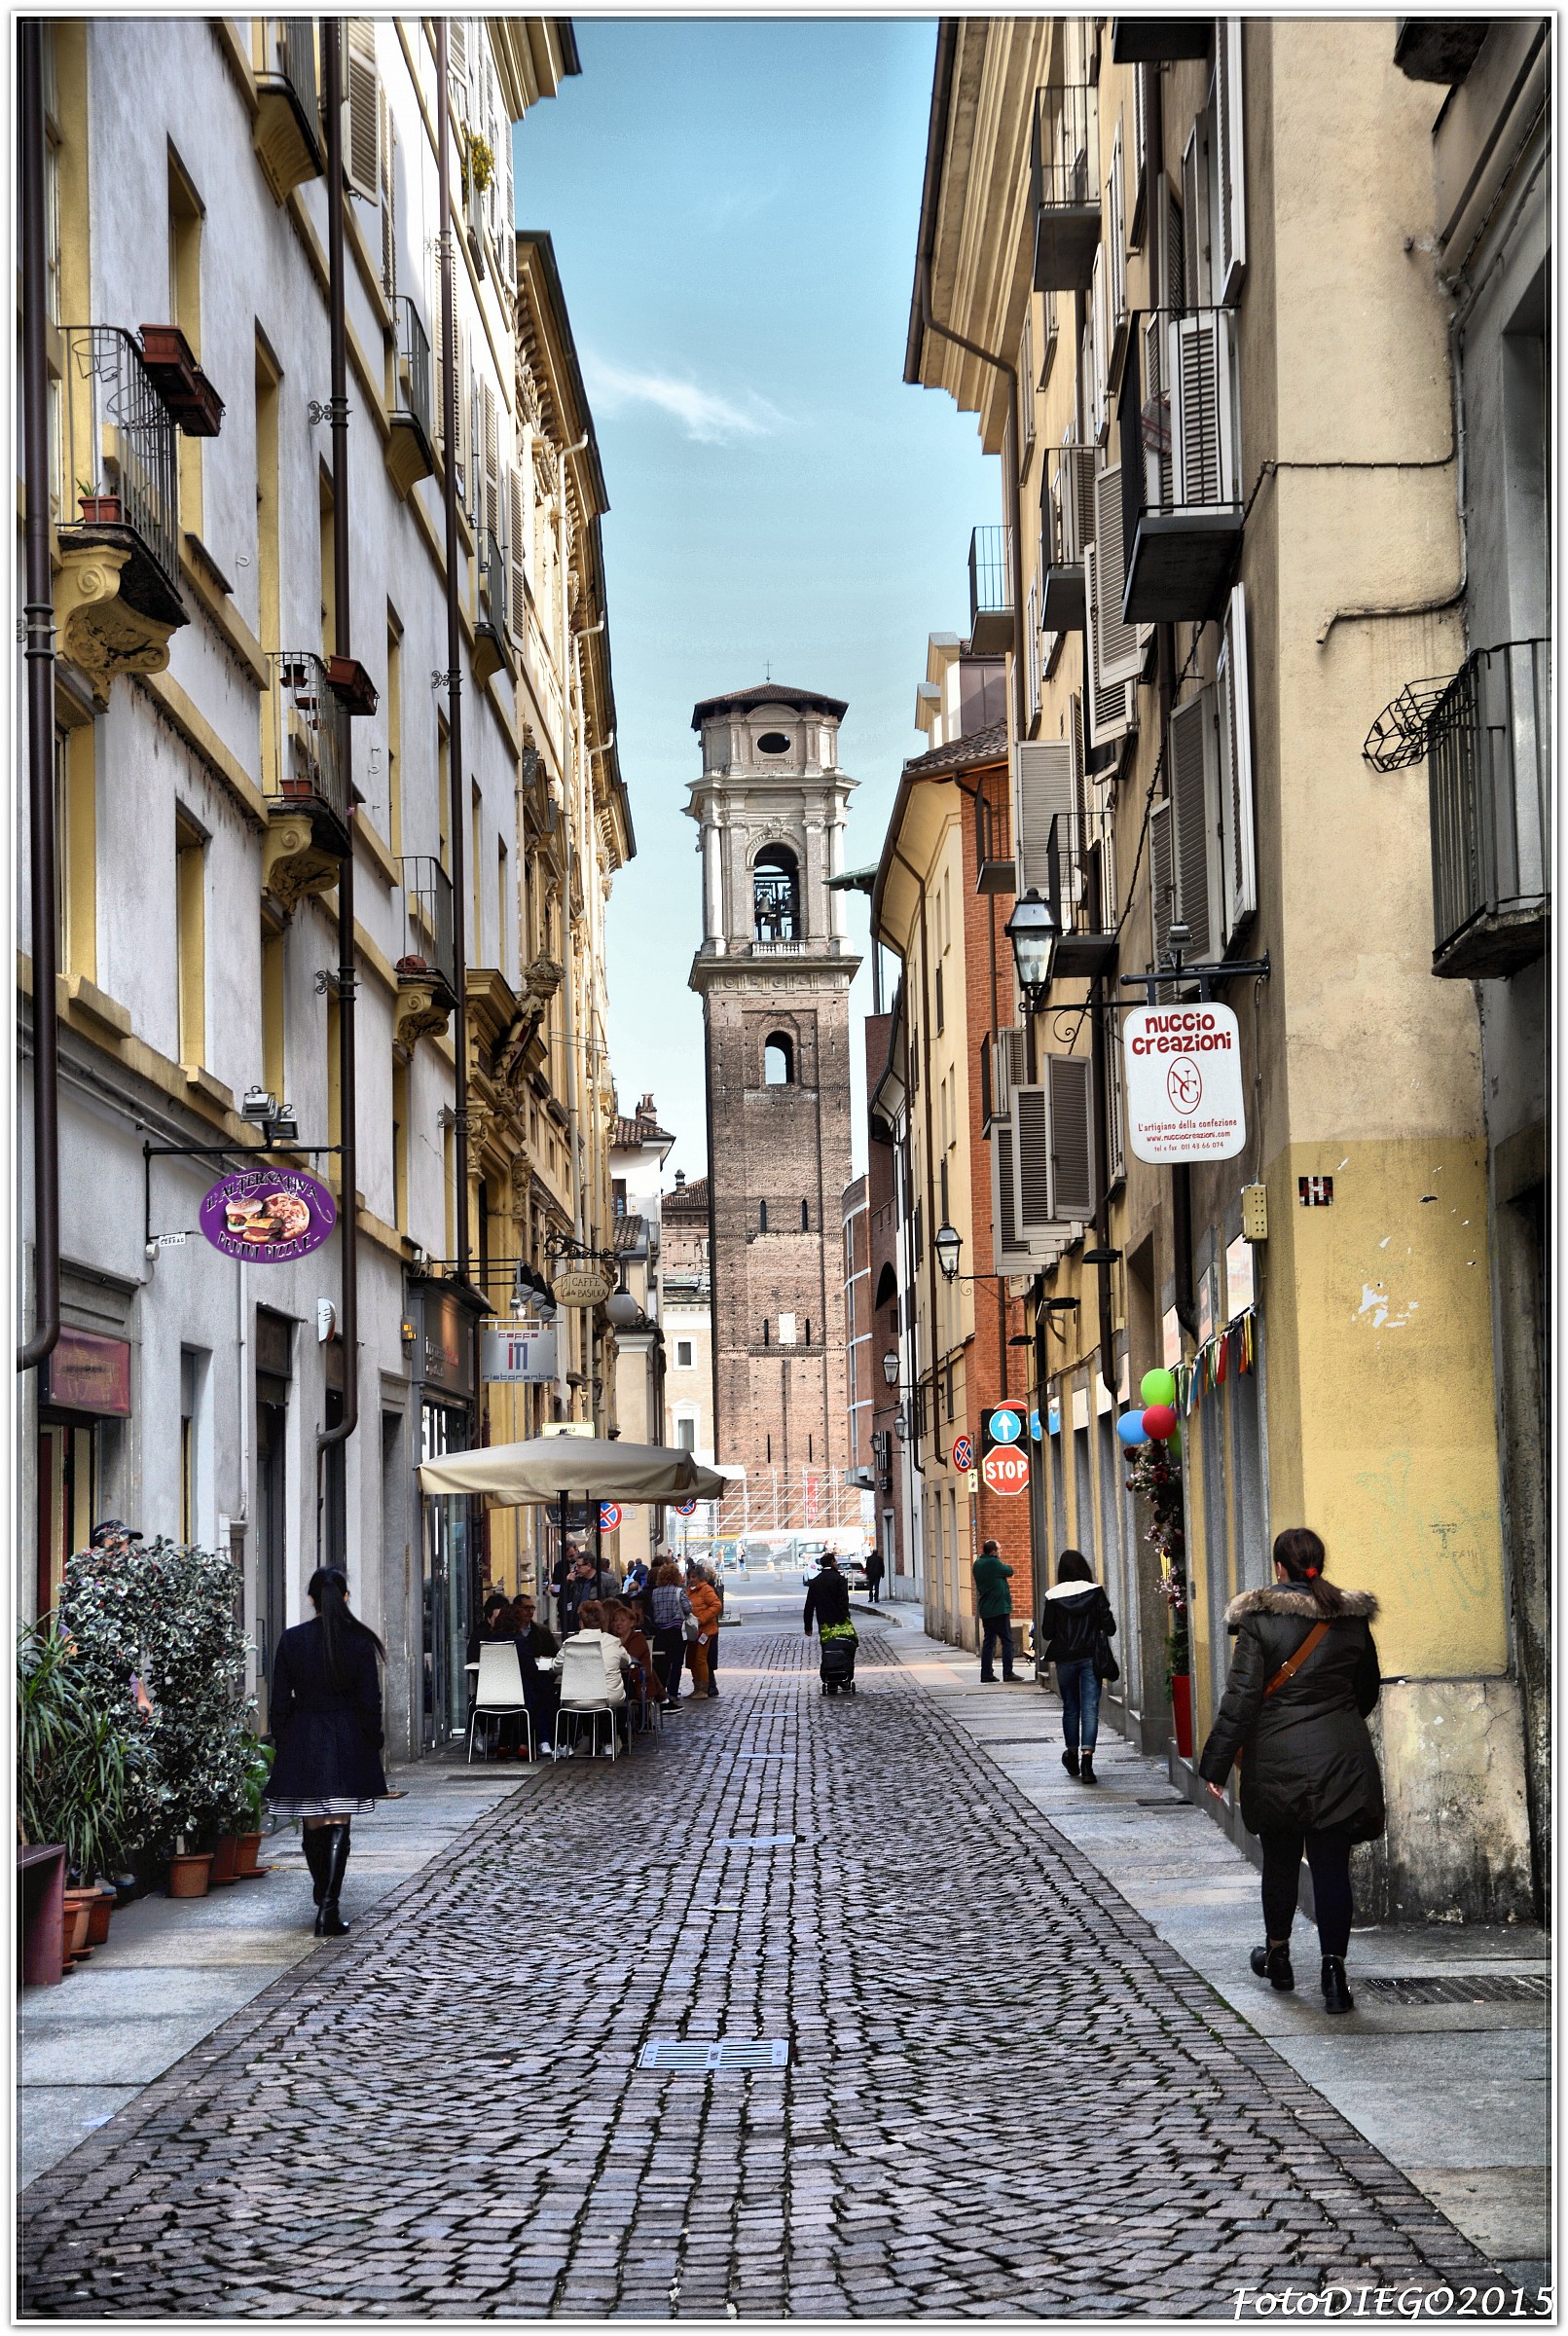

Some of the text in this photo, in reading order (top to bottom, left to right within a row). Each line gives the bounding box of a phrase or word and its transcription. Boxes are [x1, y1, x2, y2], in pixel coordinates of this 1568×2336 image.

[1145, 1013, 1216, 1034] nuccio
[1131, 1032, 1231, 1055] creazioni
[1138, 1117, 1238, 1133] L'artigiano della confezione
[1146, 1131, 1231, 1142] www.nucciocreazioni.com
[206, 1171, 333, 1223] L'ALTERNATIVA
[217, 1230, 260, 1259] PANINI
[986, 1460, 1028, 1480] STOP
